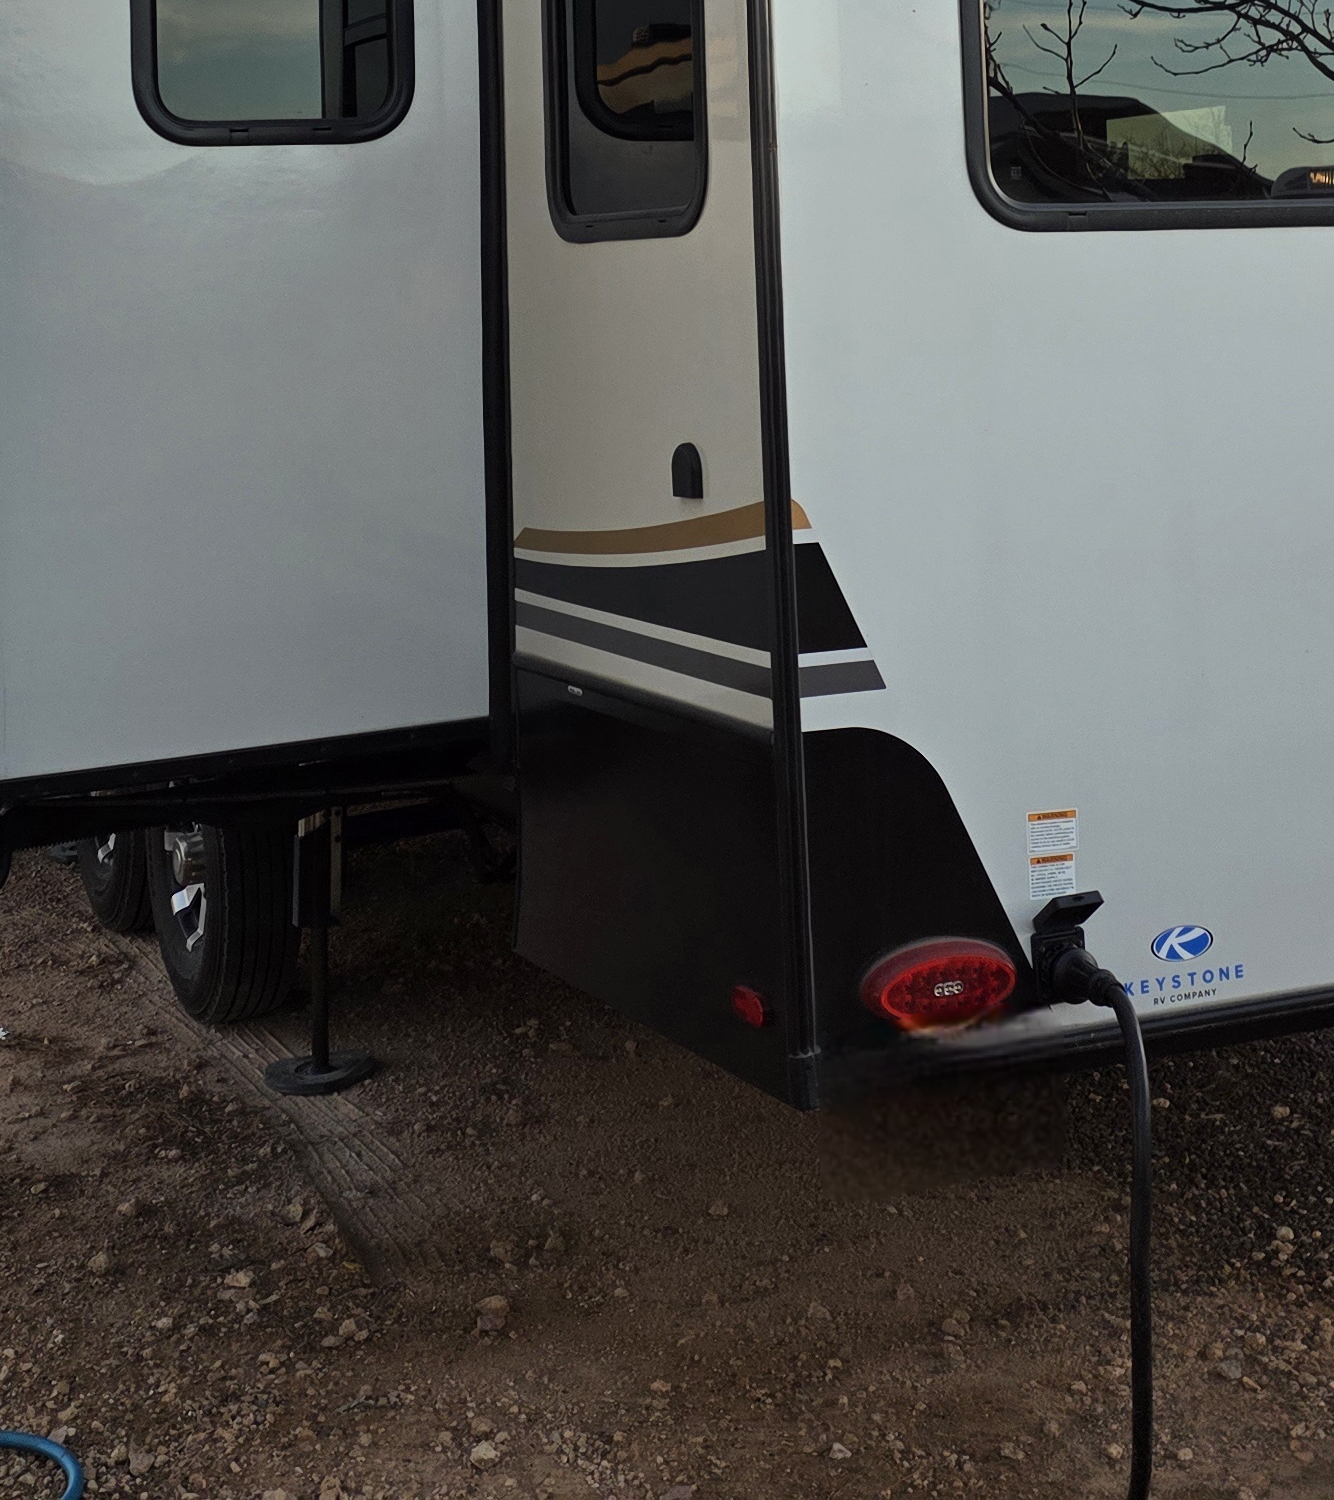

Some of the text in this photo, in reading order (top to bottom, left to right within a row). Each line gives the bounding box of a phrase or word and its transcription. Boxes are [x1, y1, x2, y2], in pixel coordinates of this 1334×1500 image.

[1124, 964, 1245, 997] KEYSTONE
[1153, 988, 1218, 1007] RV COMPANY
